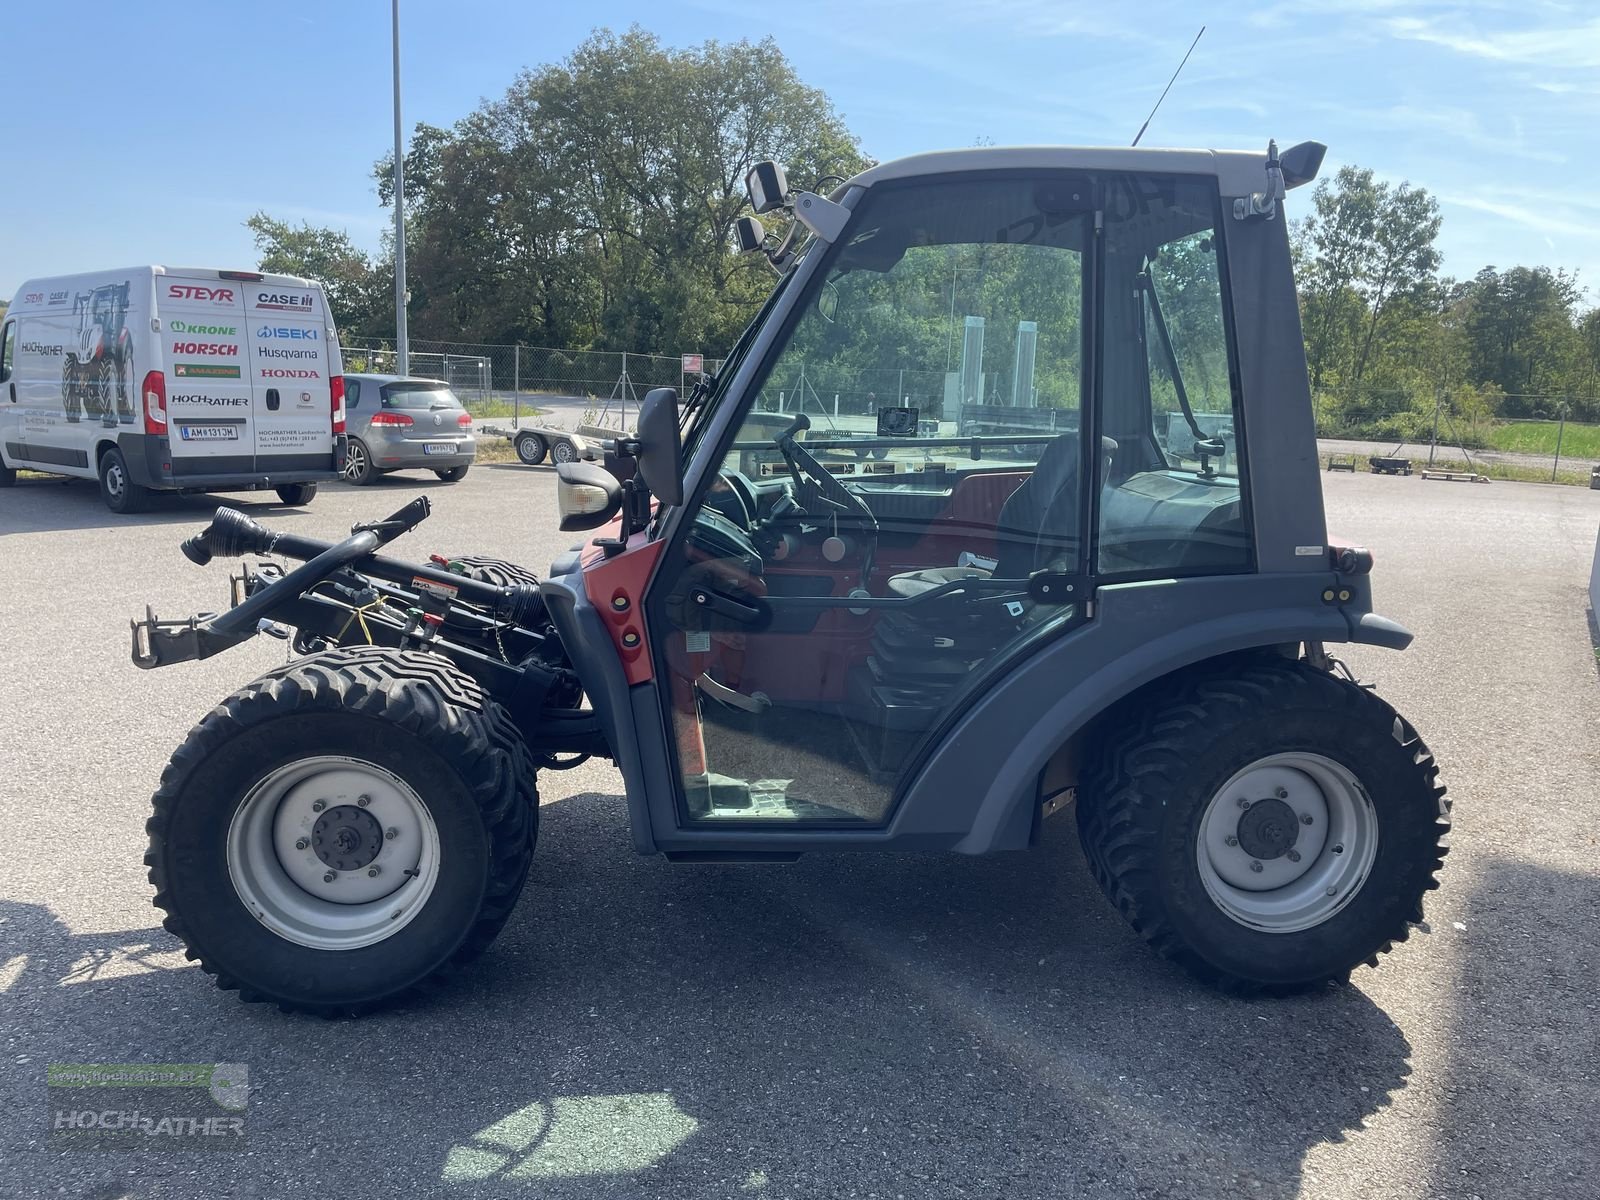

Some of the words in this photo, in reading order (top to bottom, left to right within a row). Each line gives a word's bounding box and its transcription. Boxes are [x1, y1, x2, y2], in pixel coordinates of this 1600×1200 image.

[168, 285, 233, 302] STEYR
[258, 293, 298, 305] CASE
[187, 325, 237, 336] KRONE
[273, 327, 318, 340] ISEKI
[21, 342, 63, 356] HOCHRATHER
[173, 342, 238, 356] HORSCH
[258, 346, 318, 360] Husqvarna
[261, 369, 320, 378] HONDA
[171, 395, 249, 406] HOCHRATHER
